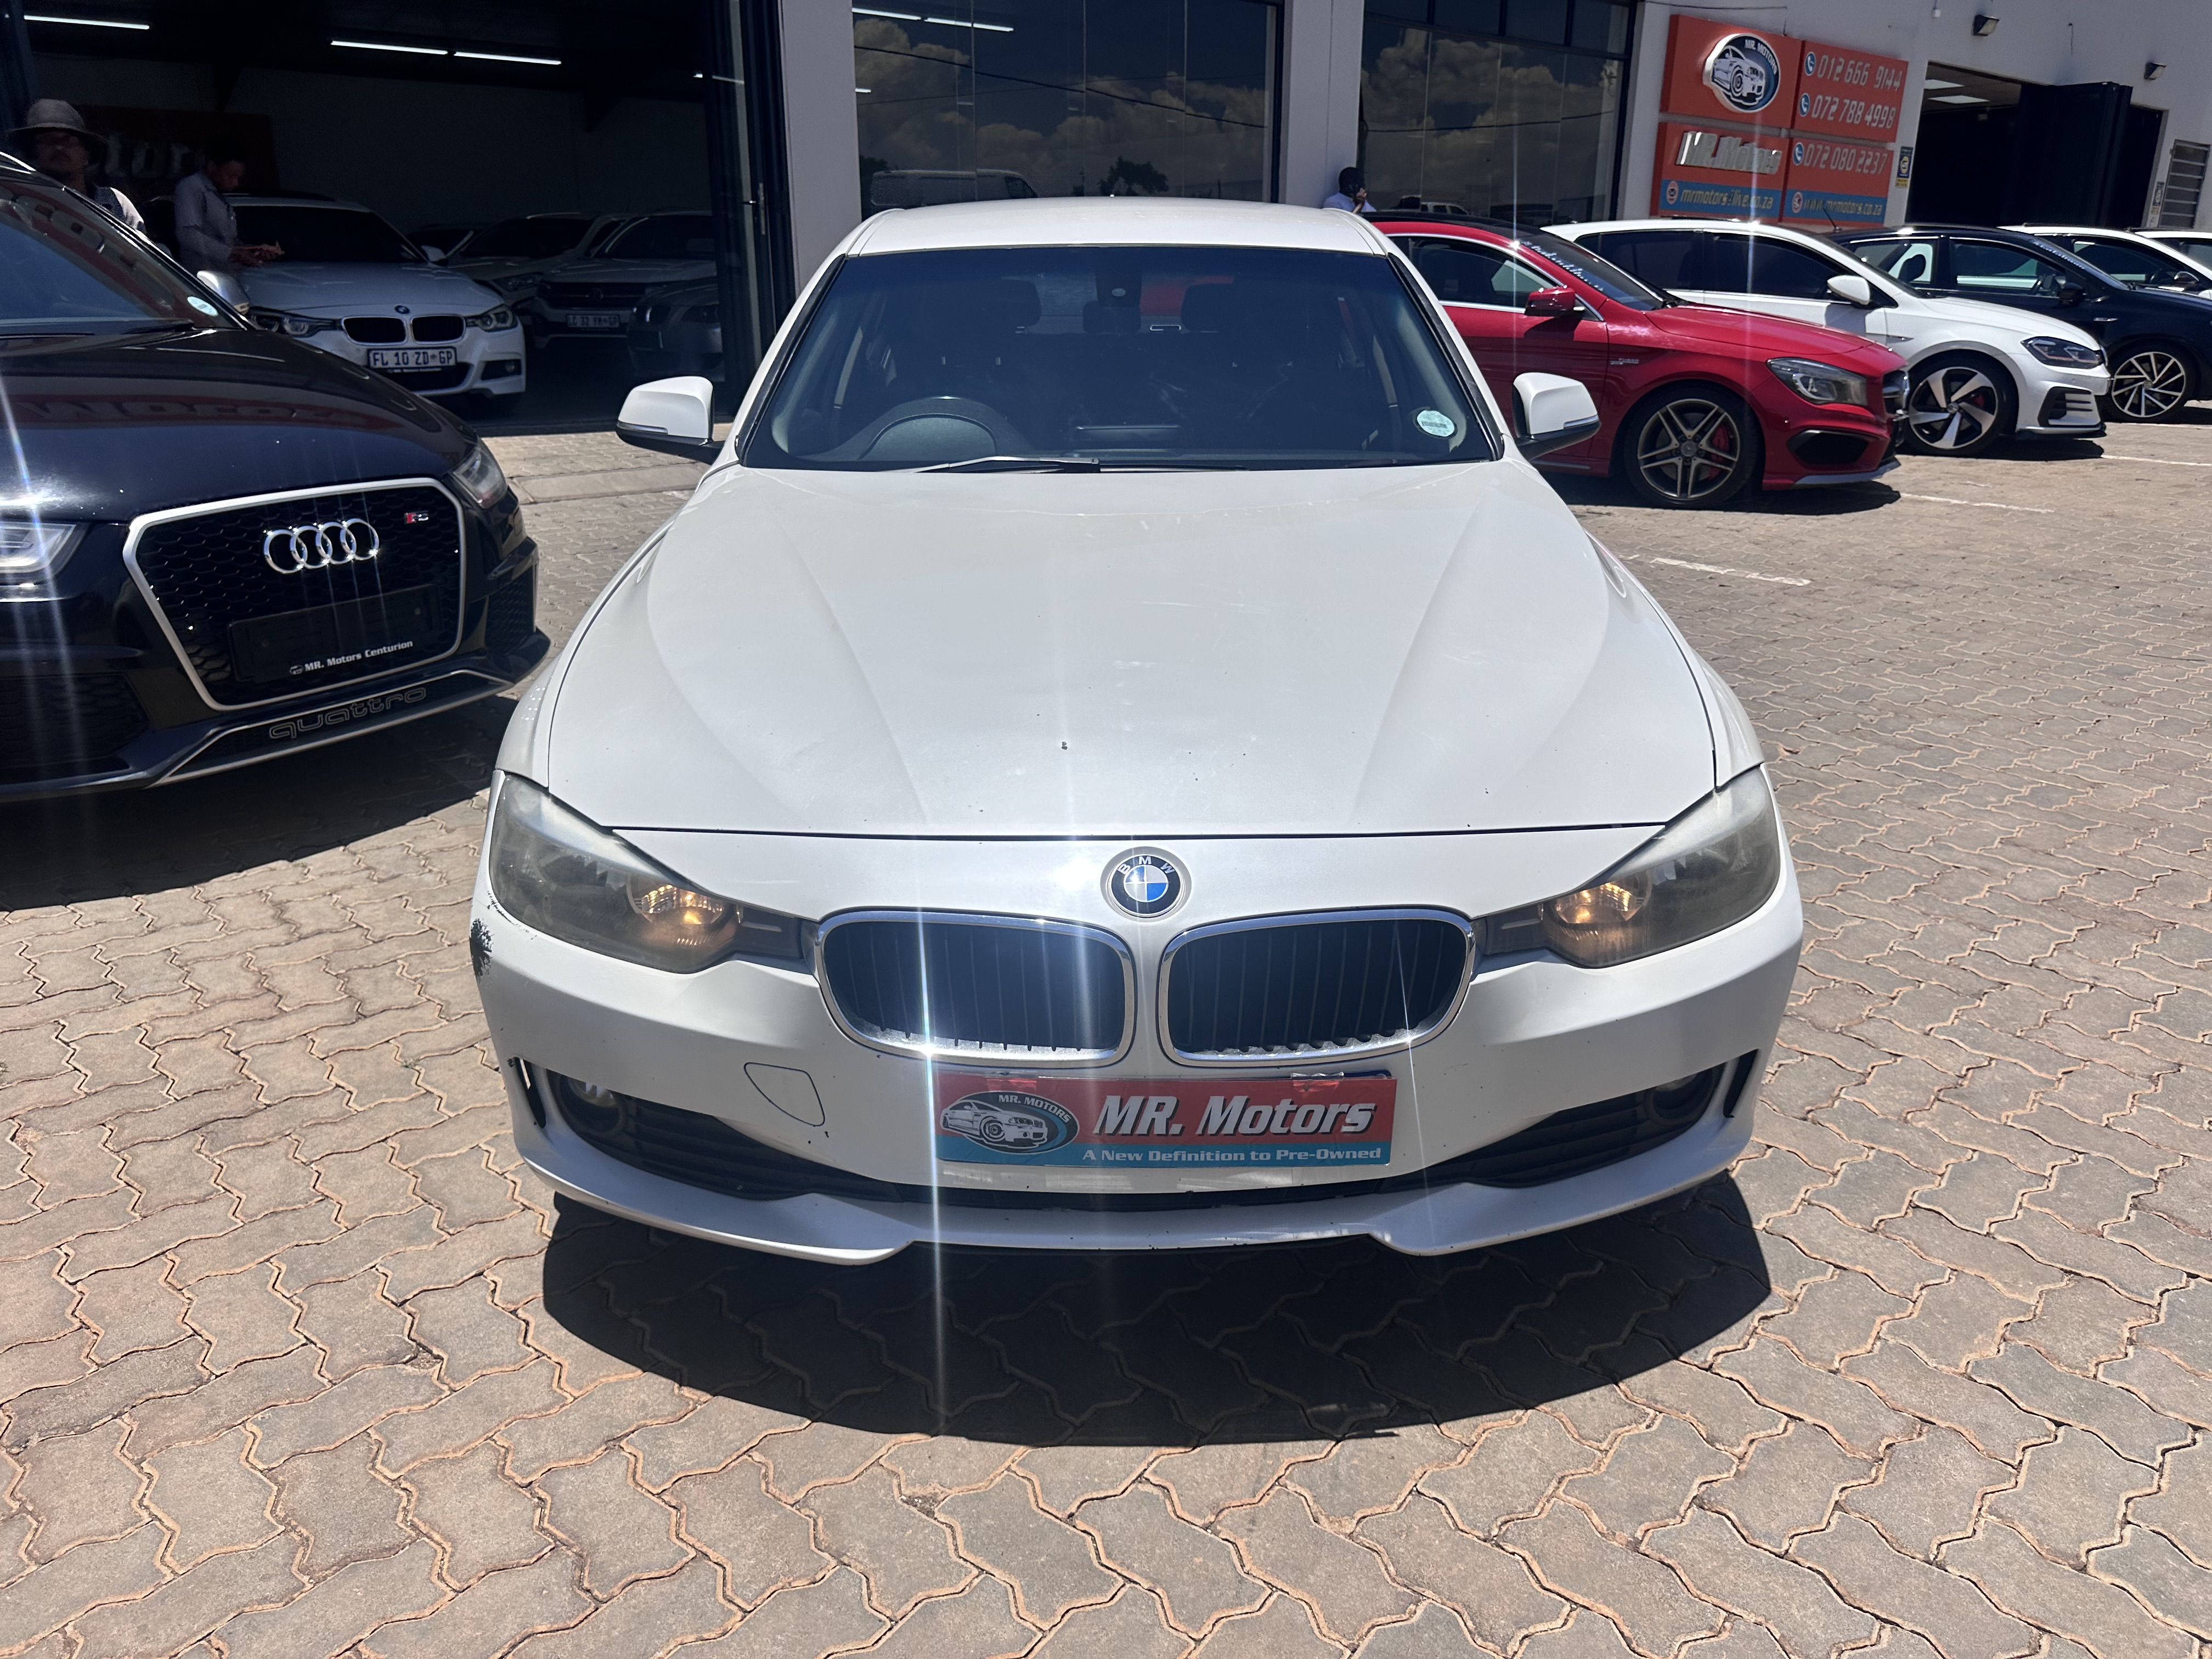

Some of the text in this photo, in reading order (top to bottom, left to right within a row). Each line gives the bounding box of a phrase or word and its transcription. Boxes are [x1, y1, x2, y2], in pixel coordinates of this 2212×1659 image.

[1744, 39, 1778, 75] MR. MOTORS
[1817, 54, 1903, 91] 012 666 9144
[1811, 94, 1897, 129] 072 788 4998
[1804, 143, 1831, 169] 072
[1830, 146, 1857, 172] 080
[1855, 150, 1888, 174] 2237
[373, 351, 453, 366] FL 10 ZD GP
[304, 640, 413, 672] MR. Motors Centurion
[269, 687, 426, 739] quattro
[1116, 856, 1176, 875] BMW
[998, 1094, 1071, 1123] MR. MOTORS
[1092, 1094, 1378, 1136] MR. Motors
[1082, 1147, 1381, 1161] A New Definition to Pre-Owned
